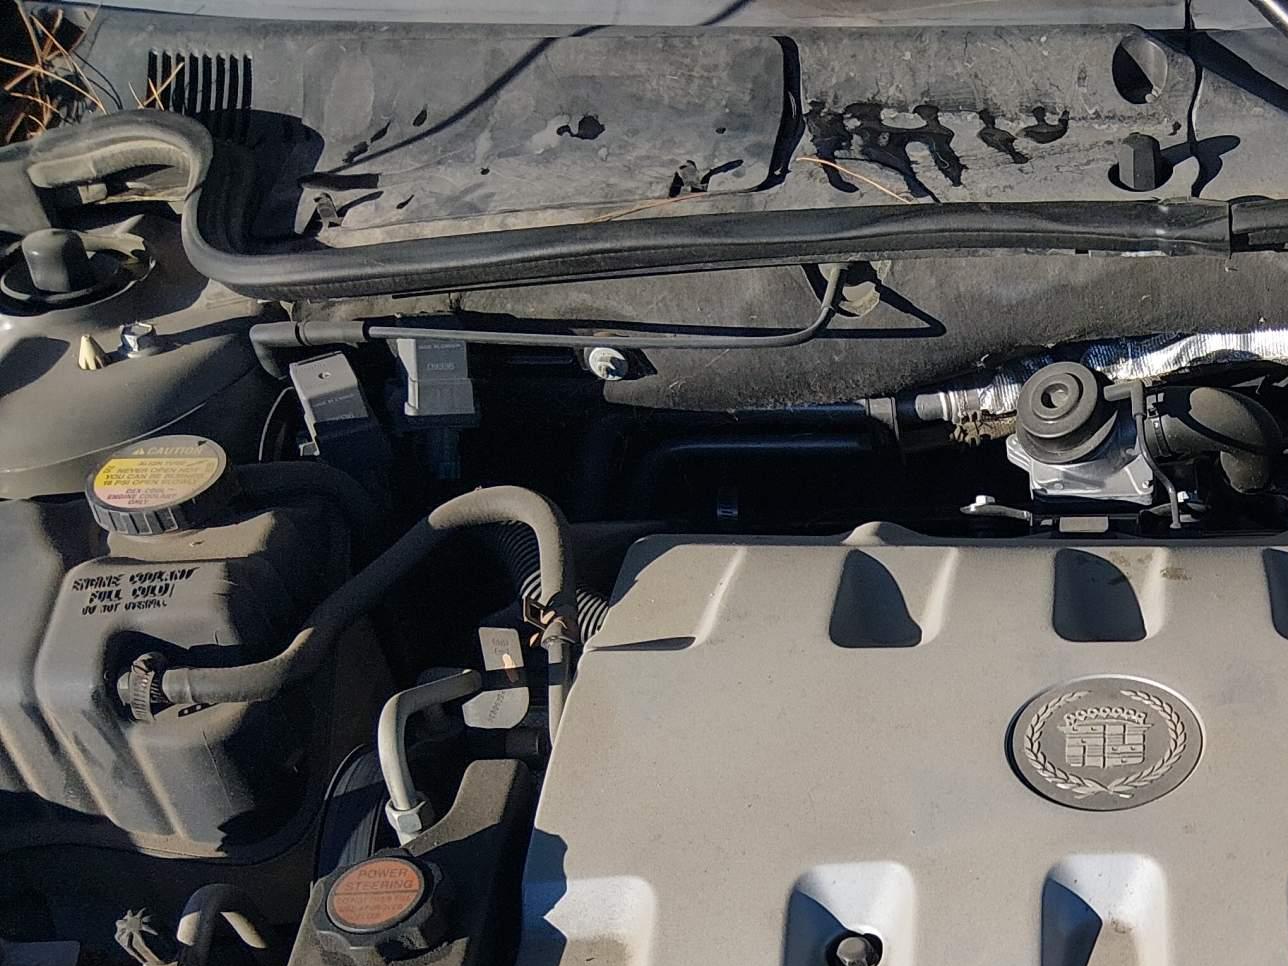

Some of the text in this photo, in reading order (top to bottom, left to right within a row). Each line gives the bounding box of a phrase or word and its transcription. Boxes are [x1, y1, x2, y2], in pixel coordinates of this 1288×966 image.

[147, 446, 203, 455] CAUTION
[359, 868, 409, 879] POWER
[343, 881, 414, 892] STEERING
